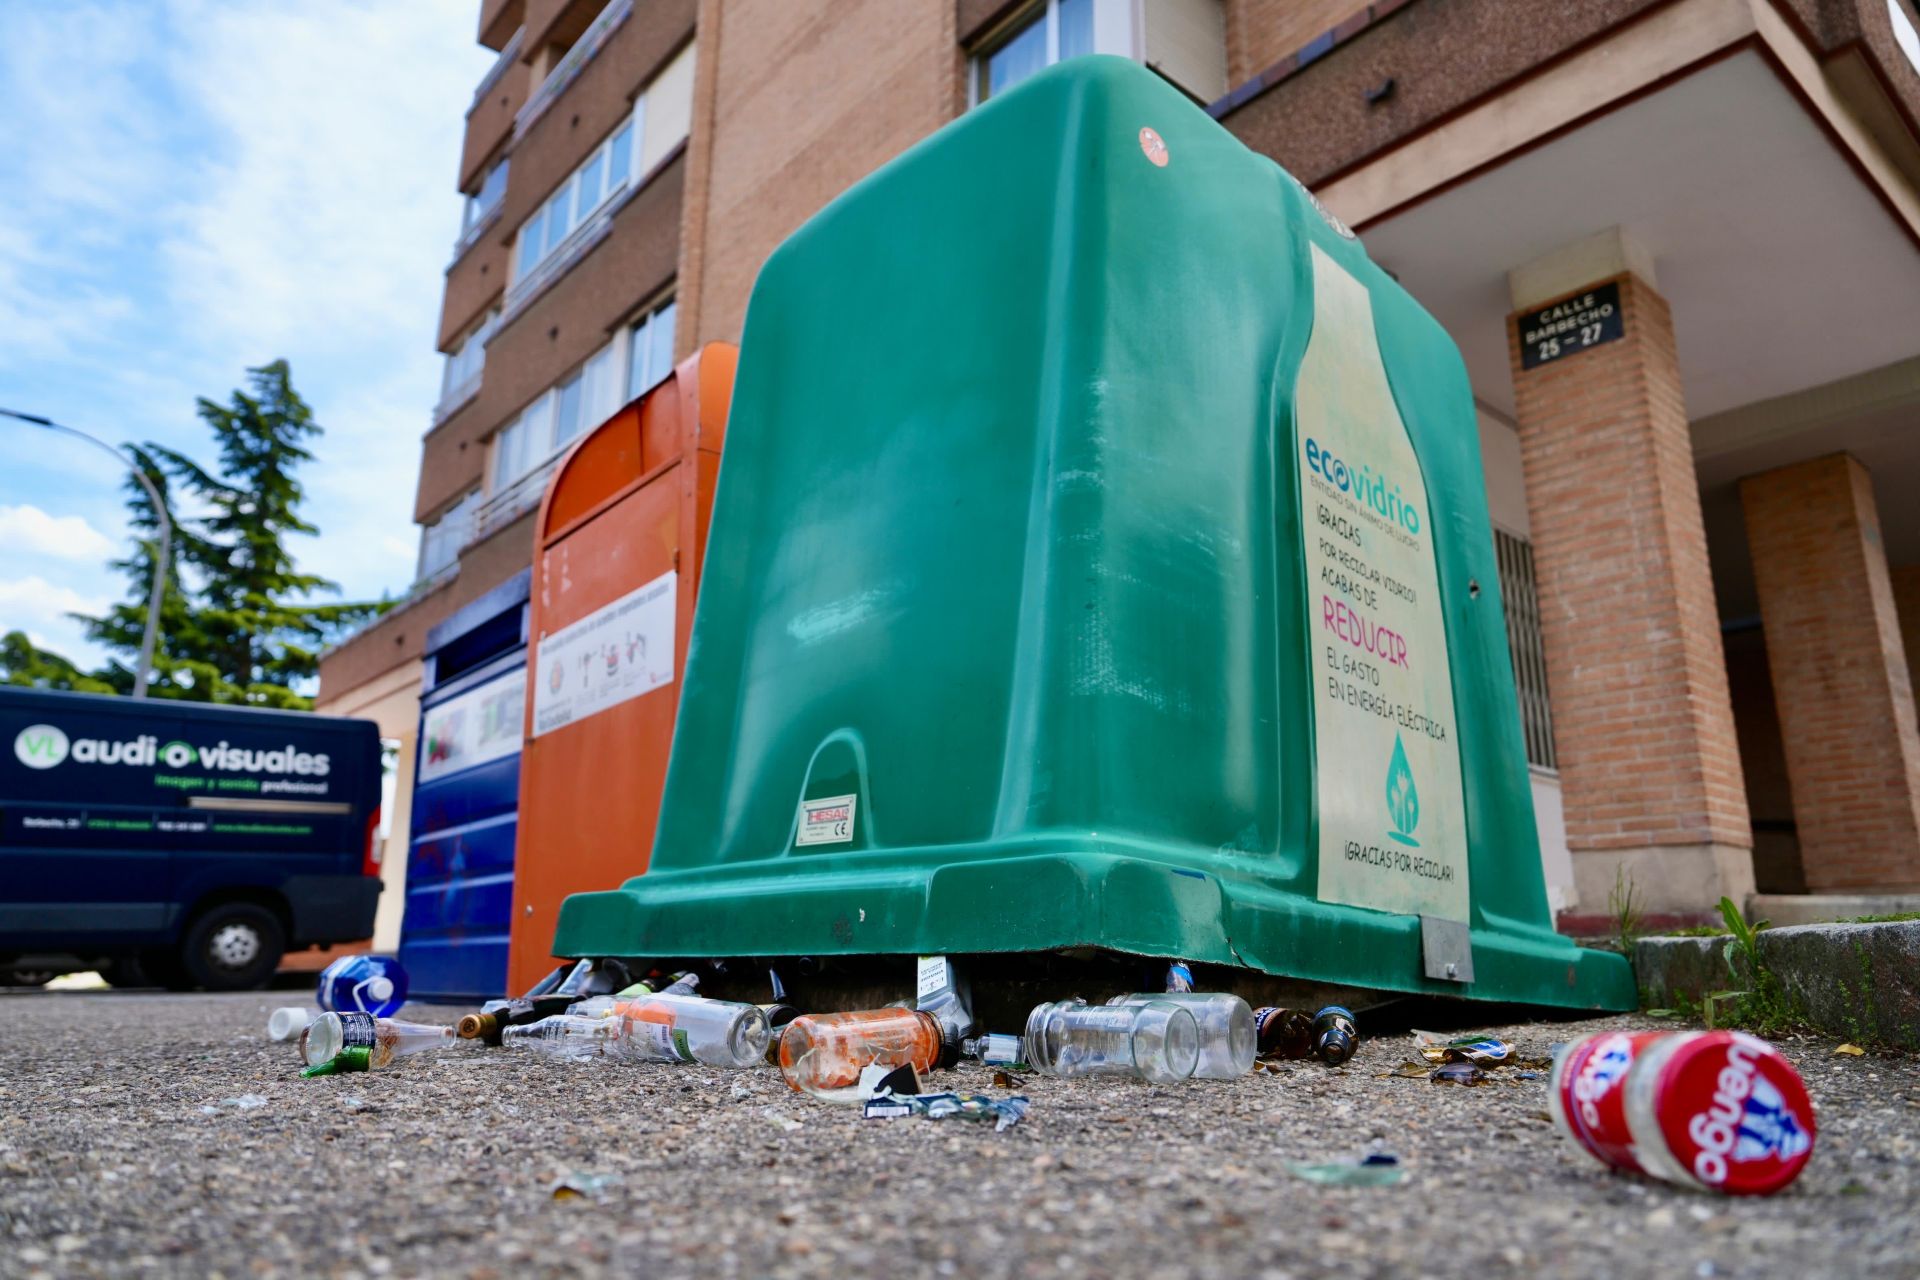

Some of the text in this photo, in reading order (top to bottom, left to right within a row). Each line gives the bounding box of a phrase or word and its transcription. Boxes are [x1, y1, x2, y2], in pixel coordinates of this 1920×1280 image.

[1525, 303, 1614, 344] BARBECHO
[1540, 293, 1595, 324] CALLE
[1580, 322, 1603, 346] 27
[1306, 438, 1419, 535] ecovidrio
[1310, 475, 1343, 506] ENTIDAD
[1345, 498, 1358, 514] SIN
[1383, 520, 1395, 538] DE
[1395, 528, 1420, 552] LUCRO
[1319, 538, 1417, 606] POR RECICLAR VIDRIO!
[1321, 566, 1378, 611] ACABAS DE
[1323, 595, 1409, 670] REDUCIR
[1327, 646, 1380, 687] EL GASTO
[1328, 676, 1446, 742] EN ENERGÍA ELÉCTRICA
[23, 734, 59, 759] VL
[1344, 840, 1454, 885] ¡GRACIAS POR RECICLAR!
